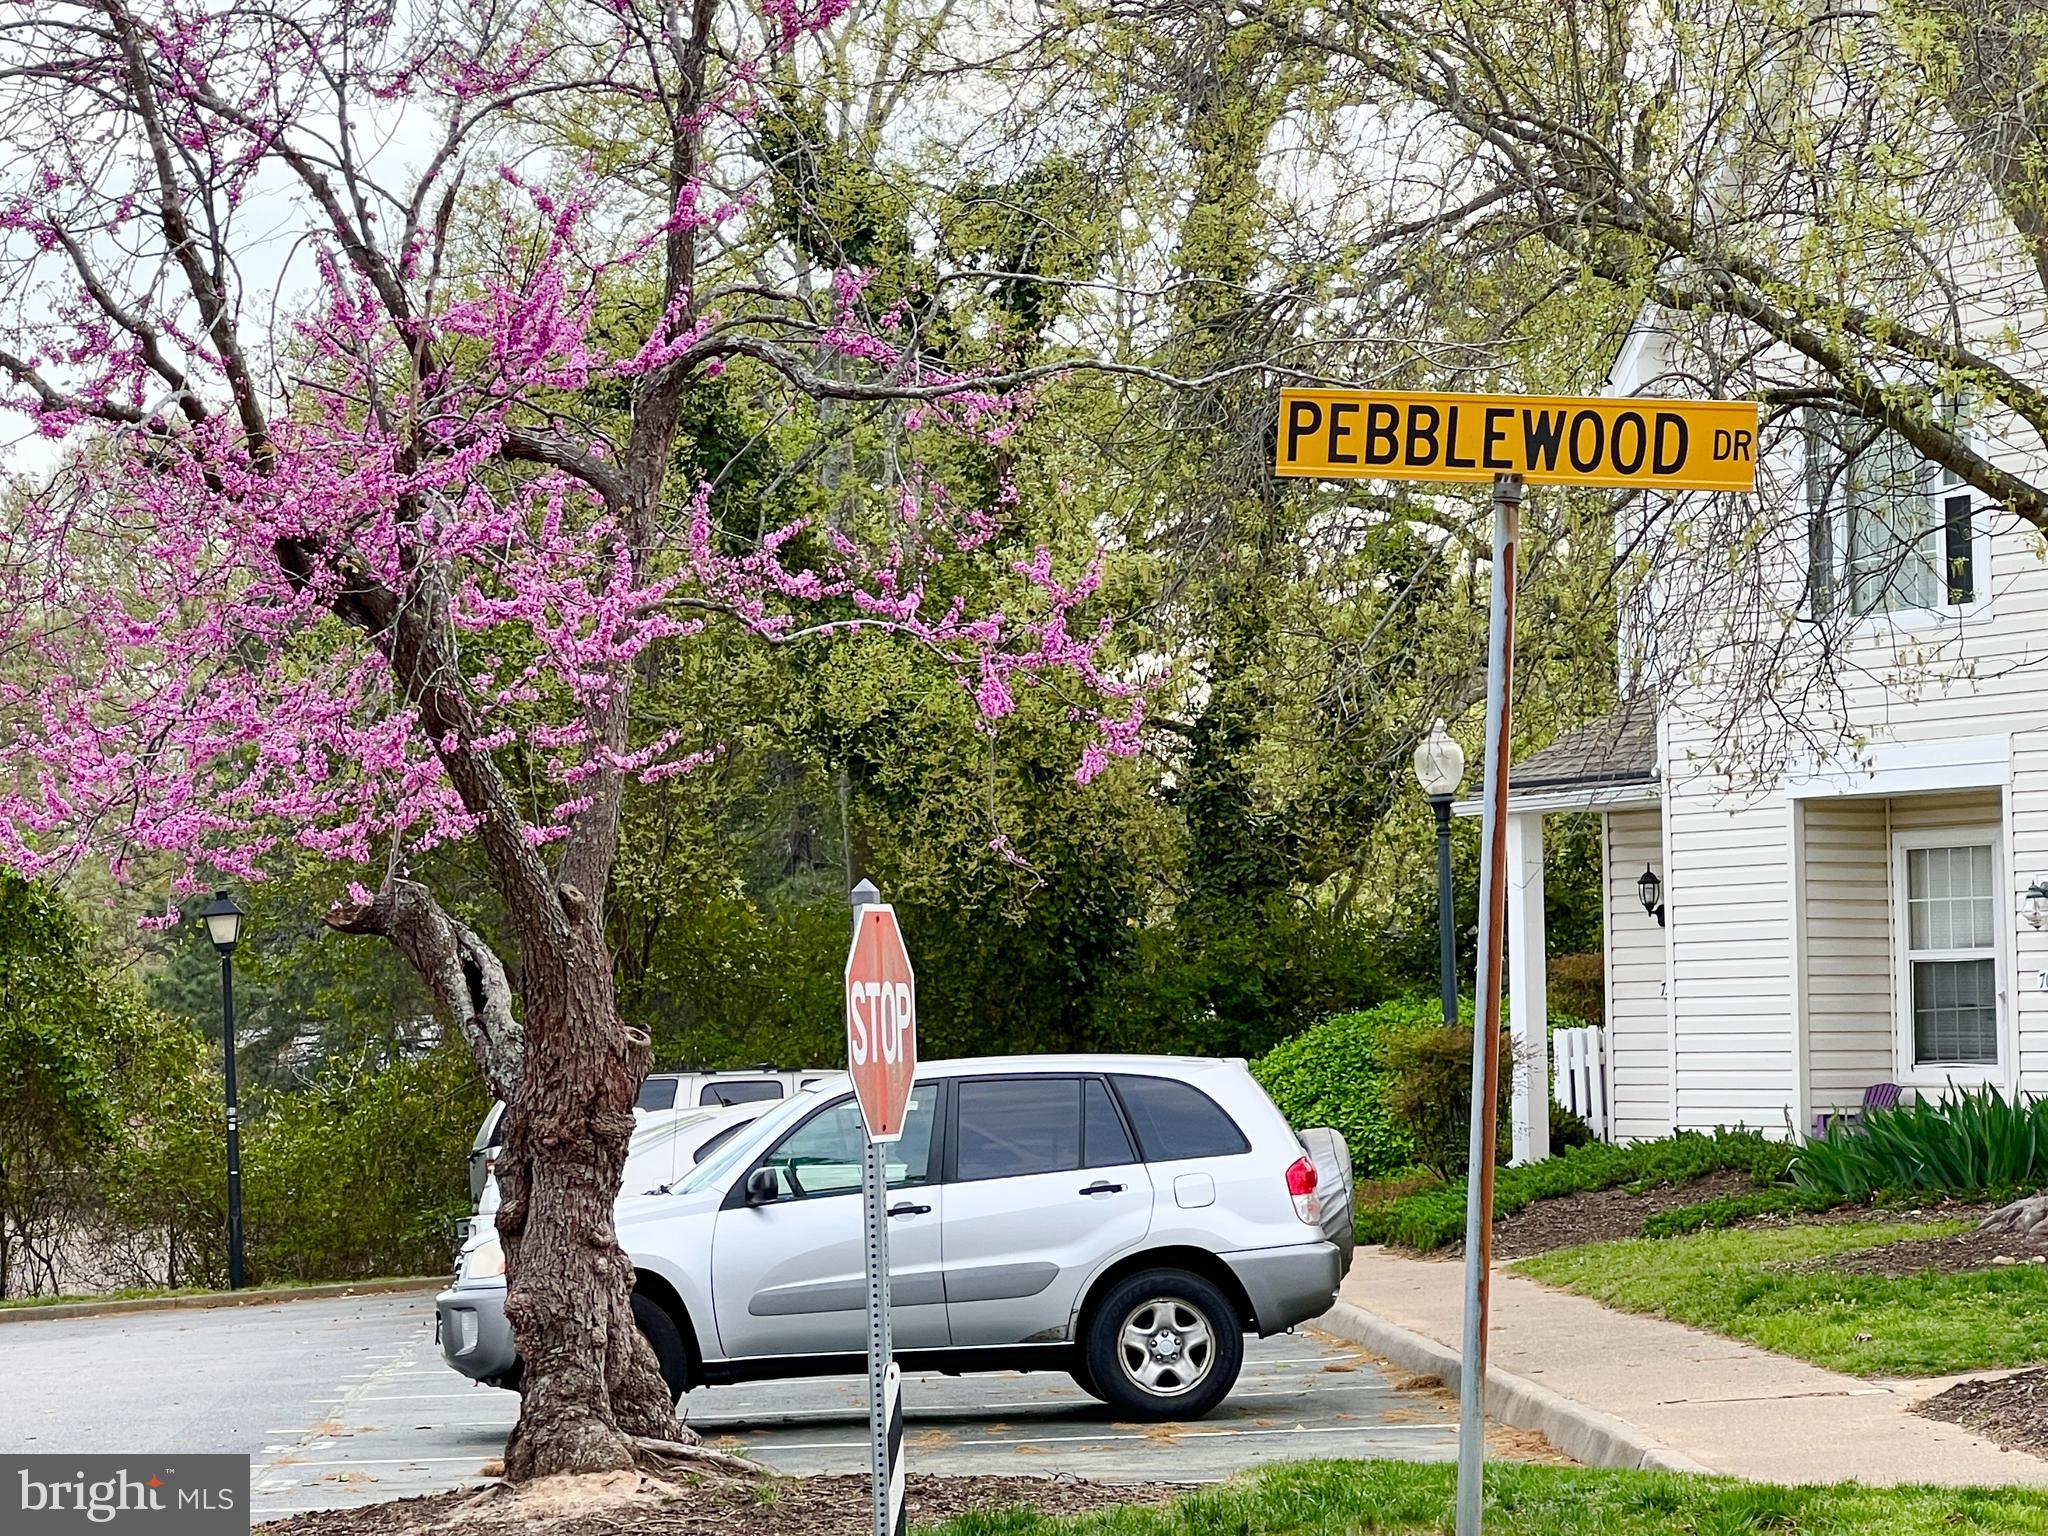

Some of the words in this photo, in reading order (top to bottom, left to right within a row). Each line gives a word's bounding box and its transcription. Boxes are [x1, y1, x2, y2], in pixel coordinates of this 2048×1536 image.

[1287, 400, 1689, 475] PEBBLEWOOD
[1713, 429, 1752, 462] DR
[851, 980, 911, 1065] STOP
